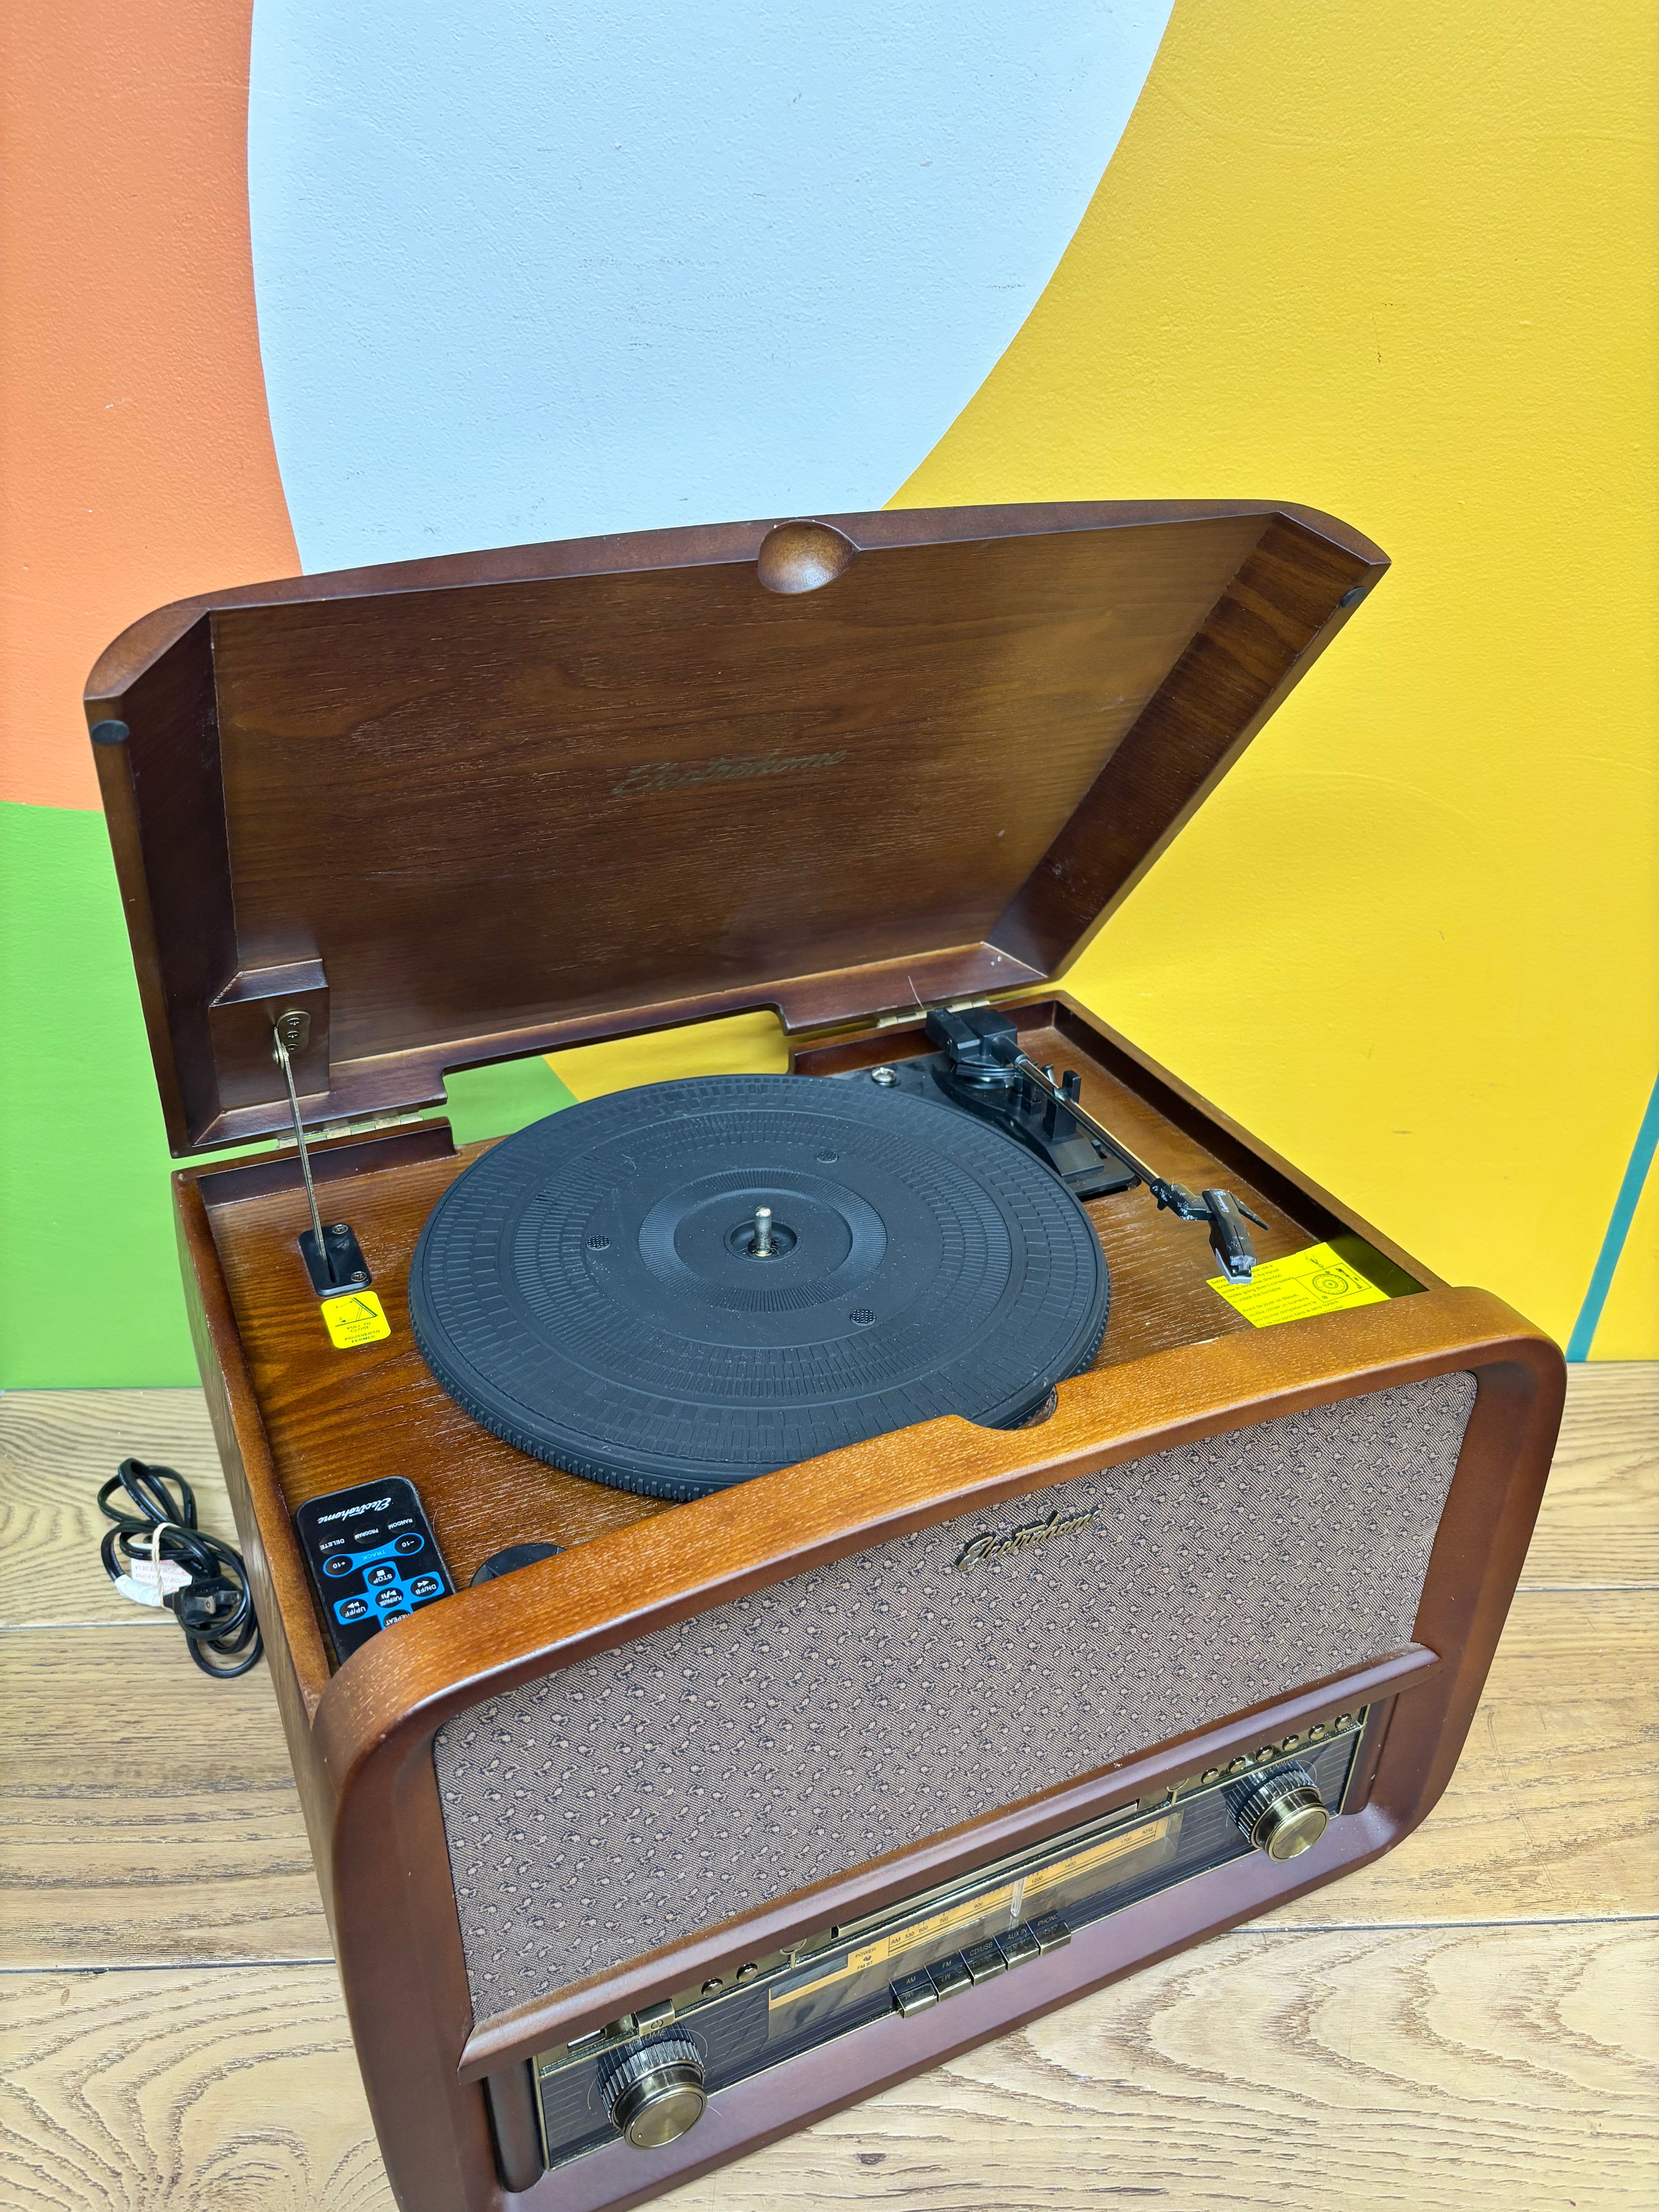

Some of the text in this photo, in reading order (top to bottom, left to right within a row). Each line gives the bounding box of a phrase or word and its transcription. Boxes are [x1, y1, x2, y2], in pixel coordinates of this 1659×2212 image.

[352, 1335, 375, 1343] FERMER
[317, 1498, 391, 1524] Electrohome
[388, 1518, 413, 1530] RANDOM
[354, 1528, 379, 1540] PROGRAM
[958, 1510, 1101, 1570] Electrohome
[319, 1538, 345, 1550] DELETE
[362, 1550, 386, 1560] TRACK
[373, 1573, 392, 1584] STOP
[415, 1584, 437, 1595] DN/FB
[379, 1595, 402, 1607] PLAY/PAUSE
[345, 1606, 366, 1618] UP/FF
[1037, 1913, 1060, 1926] PHONO
[1007, 1927, 1027, 1940] AUX IN
[855, 1947, 876, 1958] POWER
[970, 1942, 993, 1956] CD/USB
[942, 1960, 951, 1968] FM
[906, 1976, 916, 1985] AM
